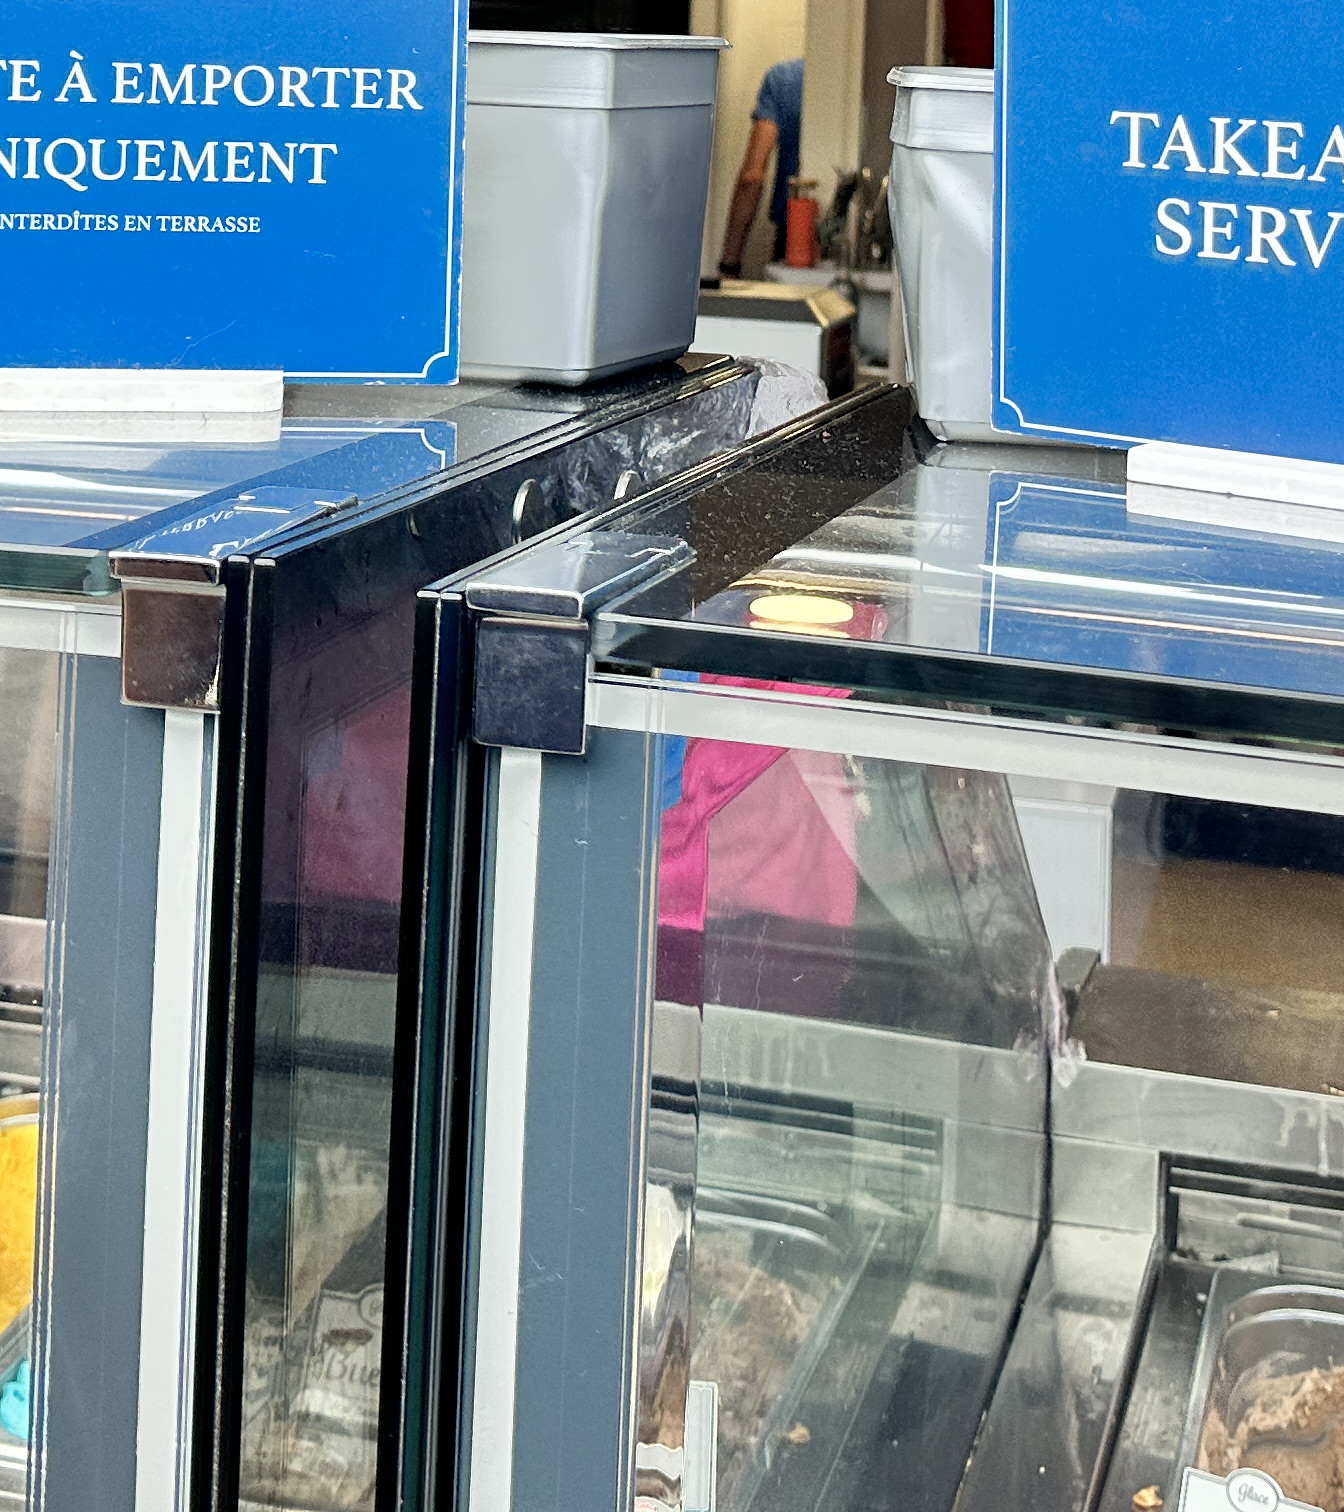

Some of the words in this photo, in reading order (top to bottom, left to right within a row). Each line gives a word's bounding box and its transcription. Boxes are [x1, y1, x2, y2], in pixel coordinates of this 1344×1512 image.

[54, 50, 97, 102] À
[111, 63, 423, 109] EMPORTER
[124, 215, 152, 231] EN
[156, 216, 260, 232] TERRASSE
[1238, 1482, 1269, 1505] Glace
